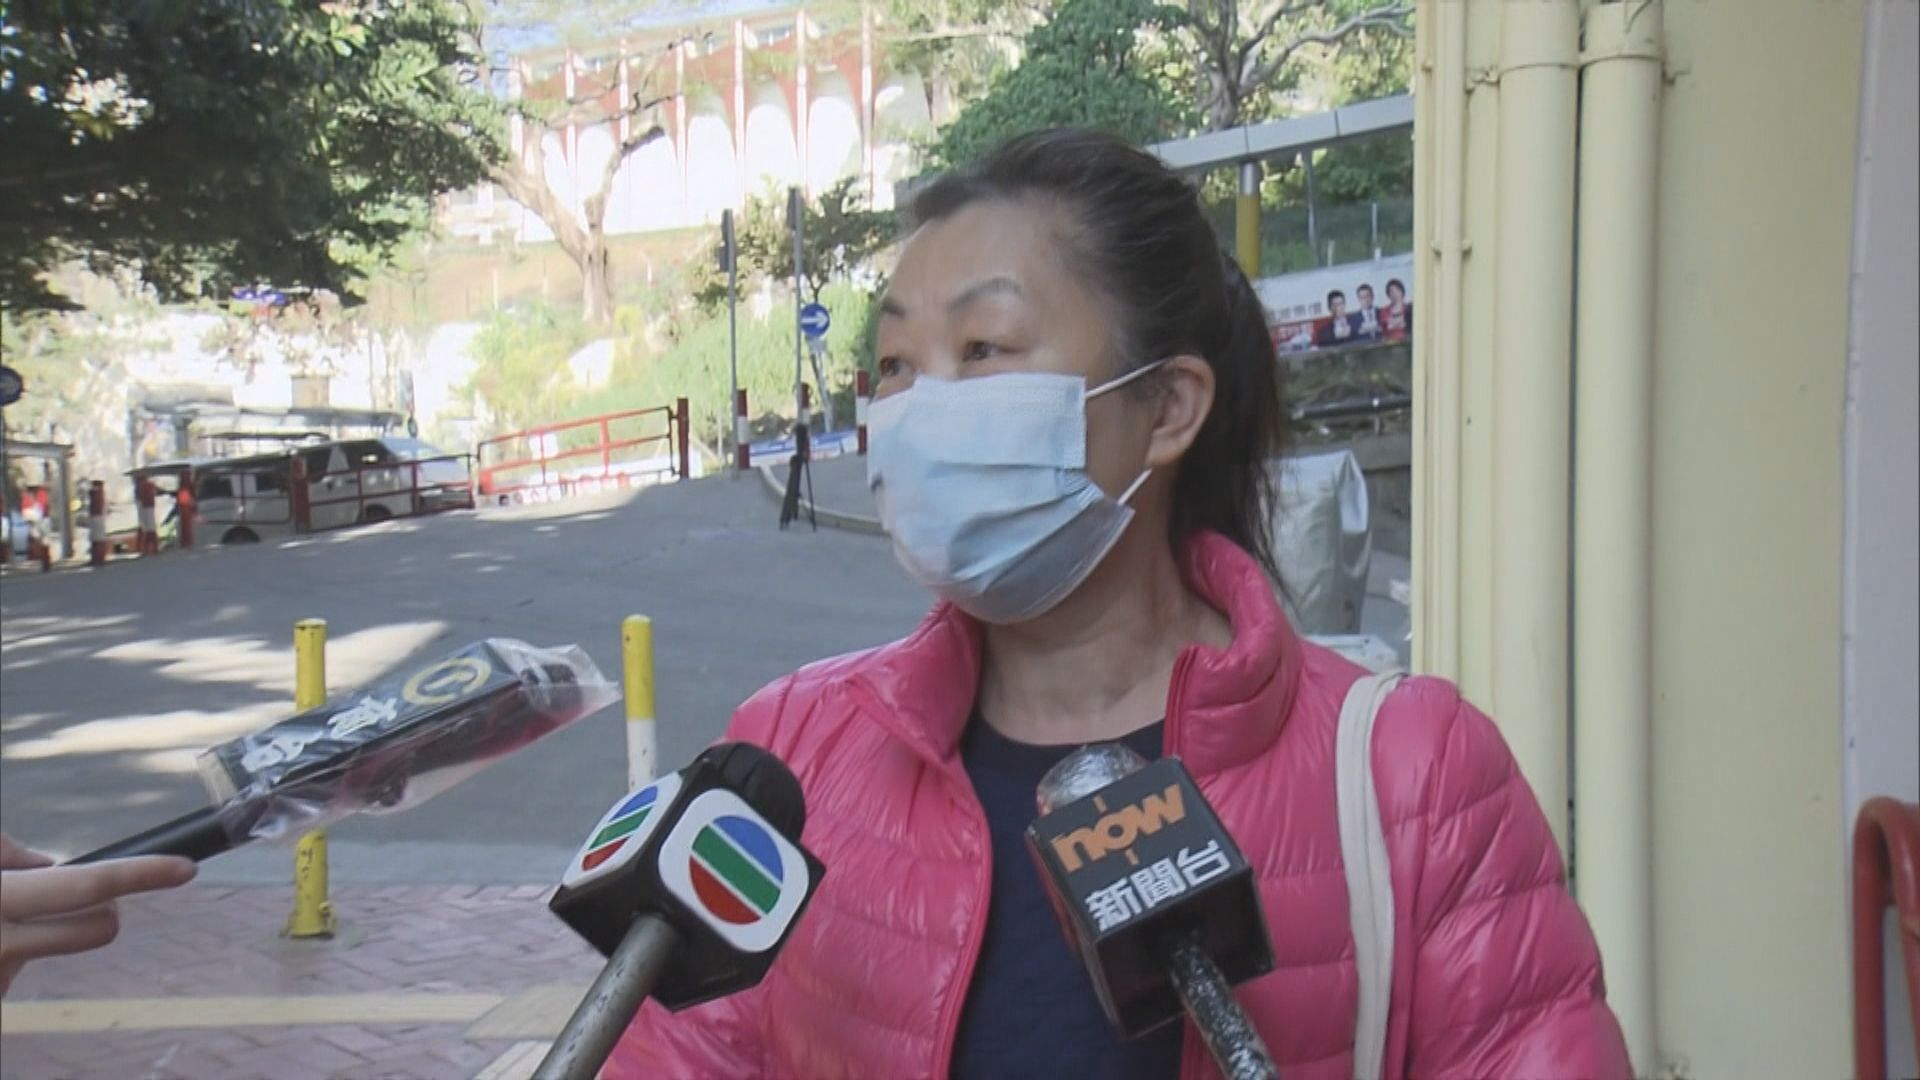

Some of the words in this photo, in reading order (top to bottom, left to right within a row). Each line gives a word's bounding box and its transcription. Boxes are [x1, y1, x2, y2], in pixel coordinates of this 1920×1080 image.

[1052, 784, 1186, 873] now
[1085, 839, 1231, 932] 新聞台
